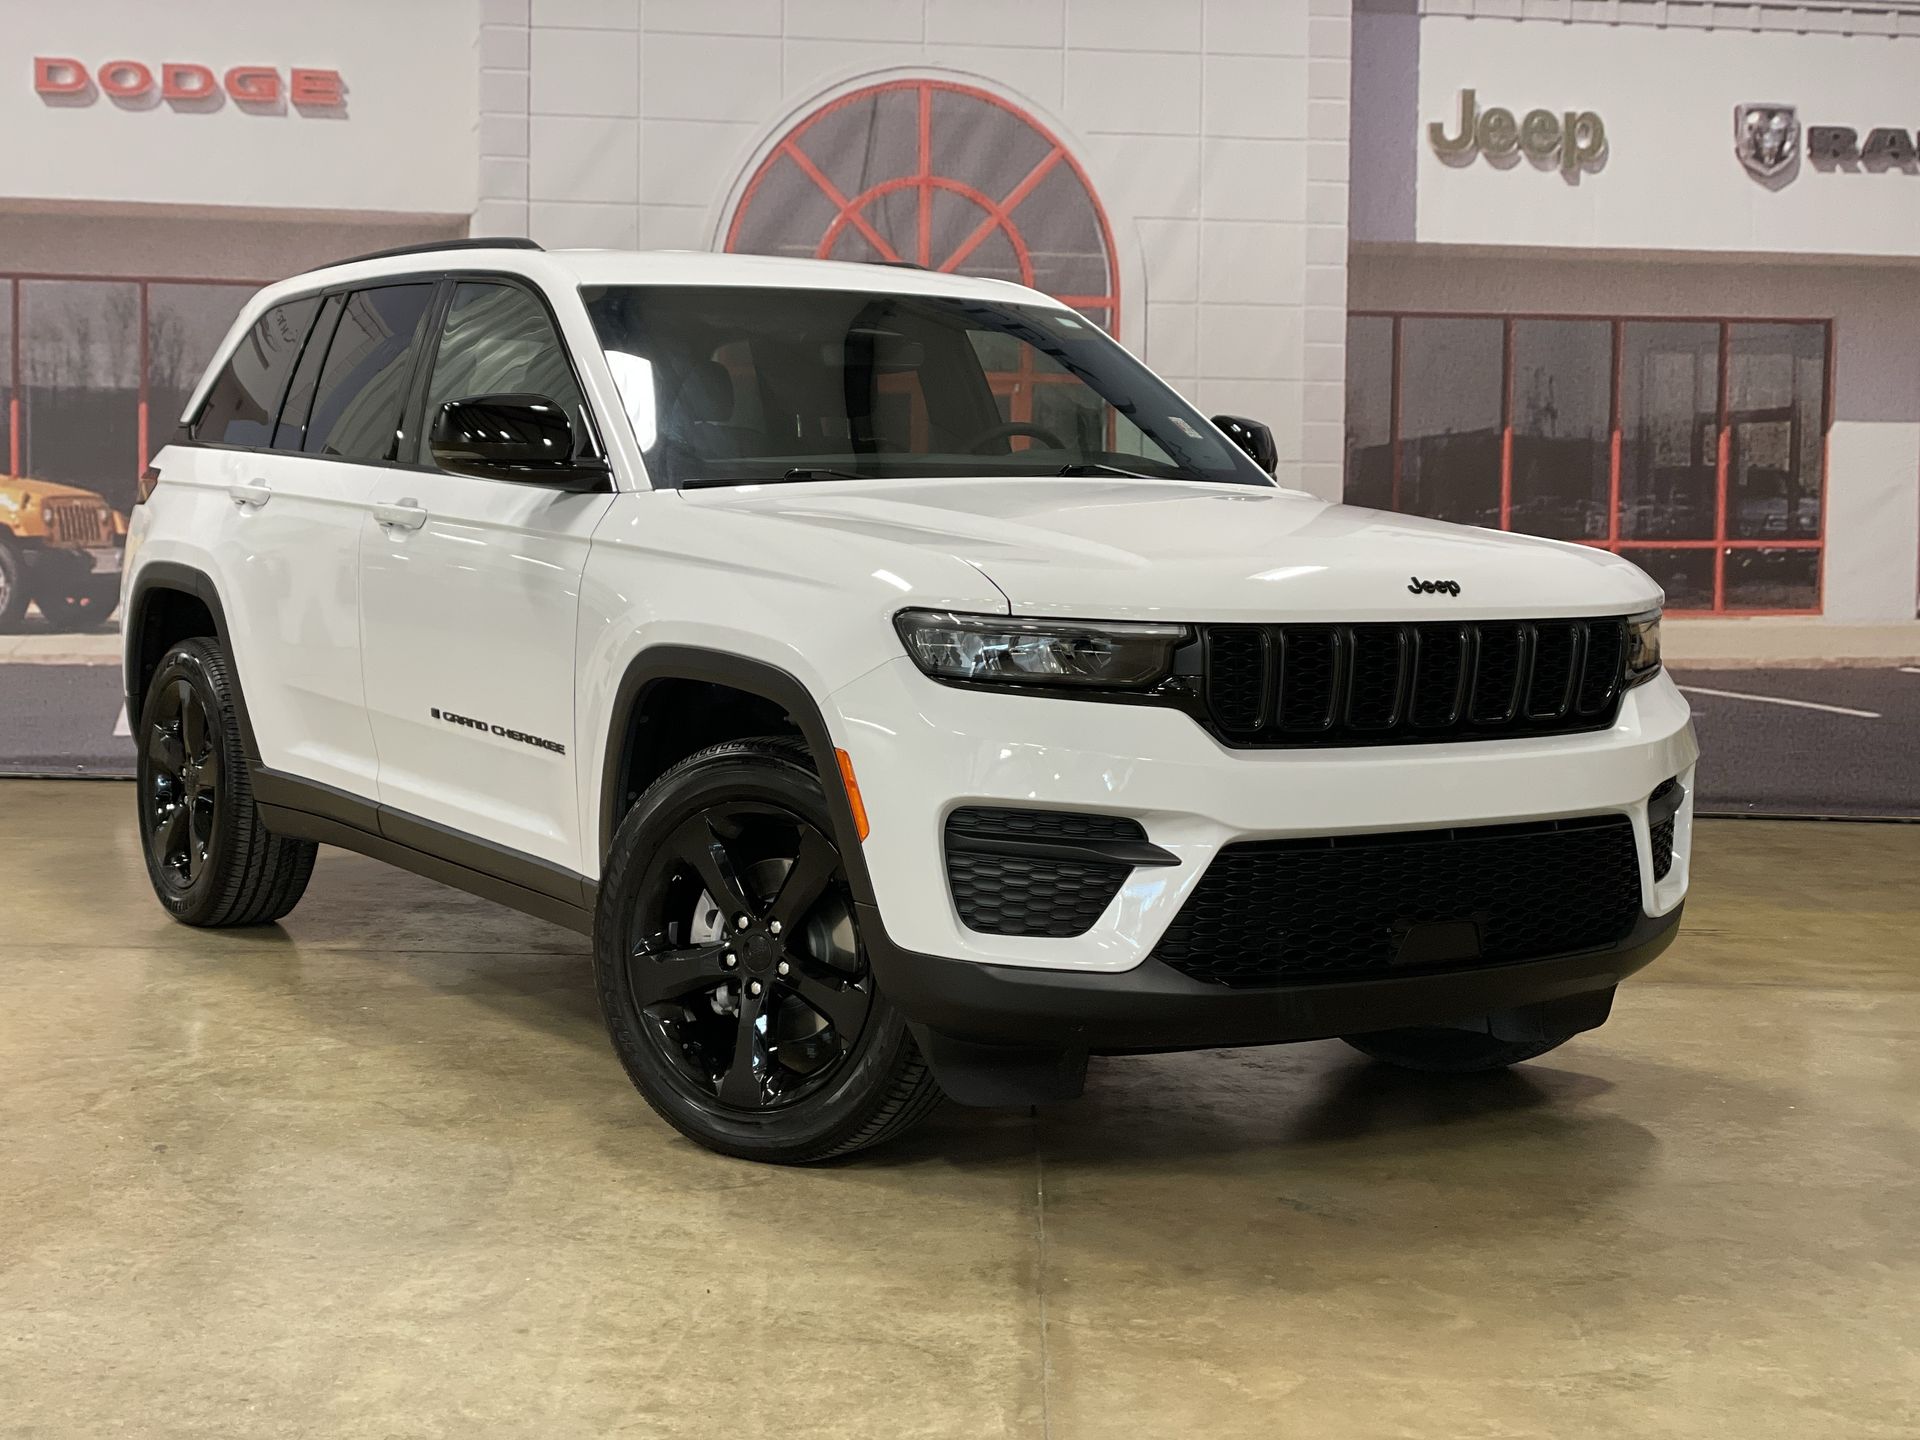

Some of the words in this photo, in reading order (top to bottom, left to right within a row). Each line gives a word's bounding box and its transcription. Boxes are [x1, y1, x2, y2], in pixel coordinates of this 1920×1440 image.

[34, 57, 345, 112] DODGE
[1428, 88, 1606, 174] Jeep
[1808, 126, 1920, 168] RA
[1407, 577, 1461, 597] Jeep
[443, 711, 489, 732] GRAND
[491, 725, 566, 756] CHEROKEE
